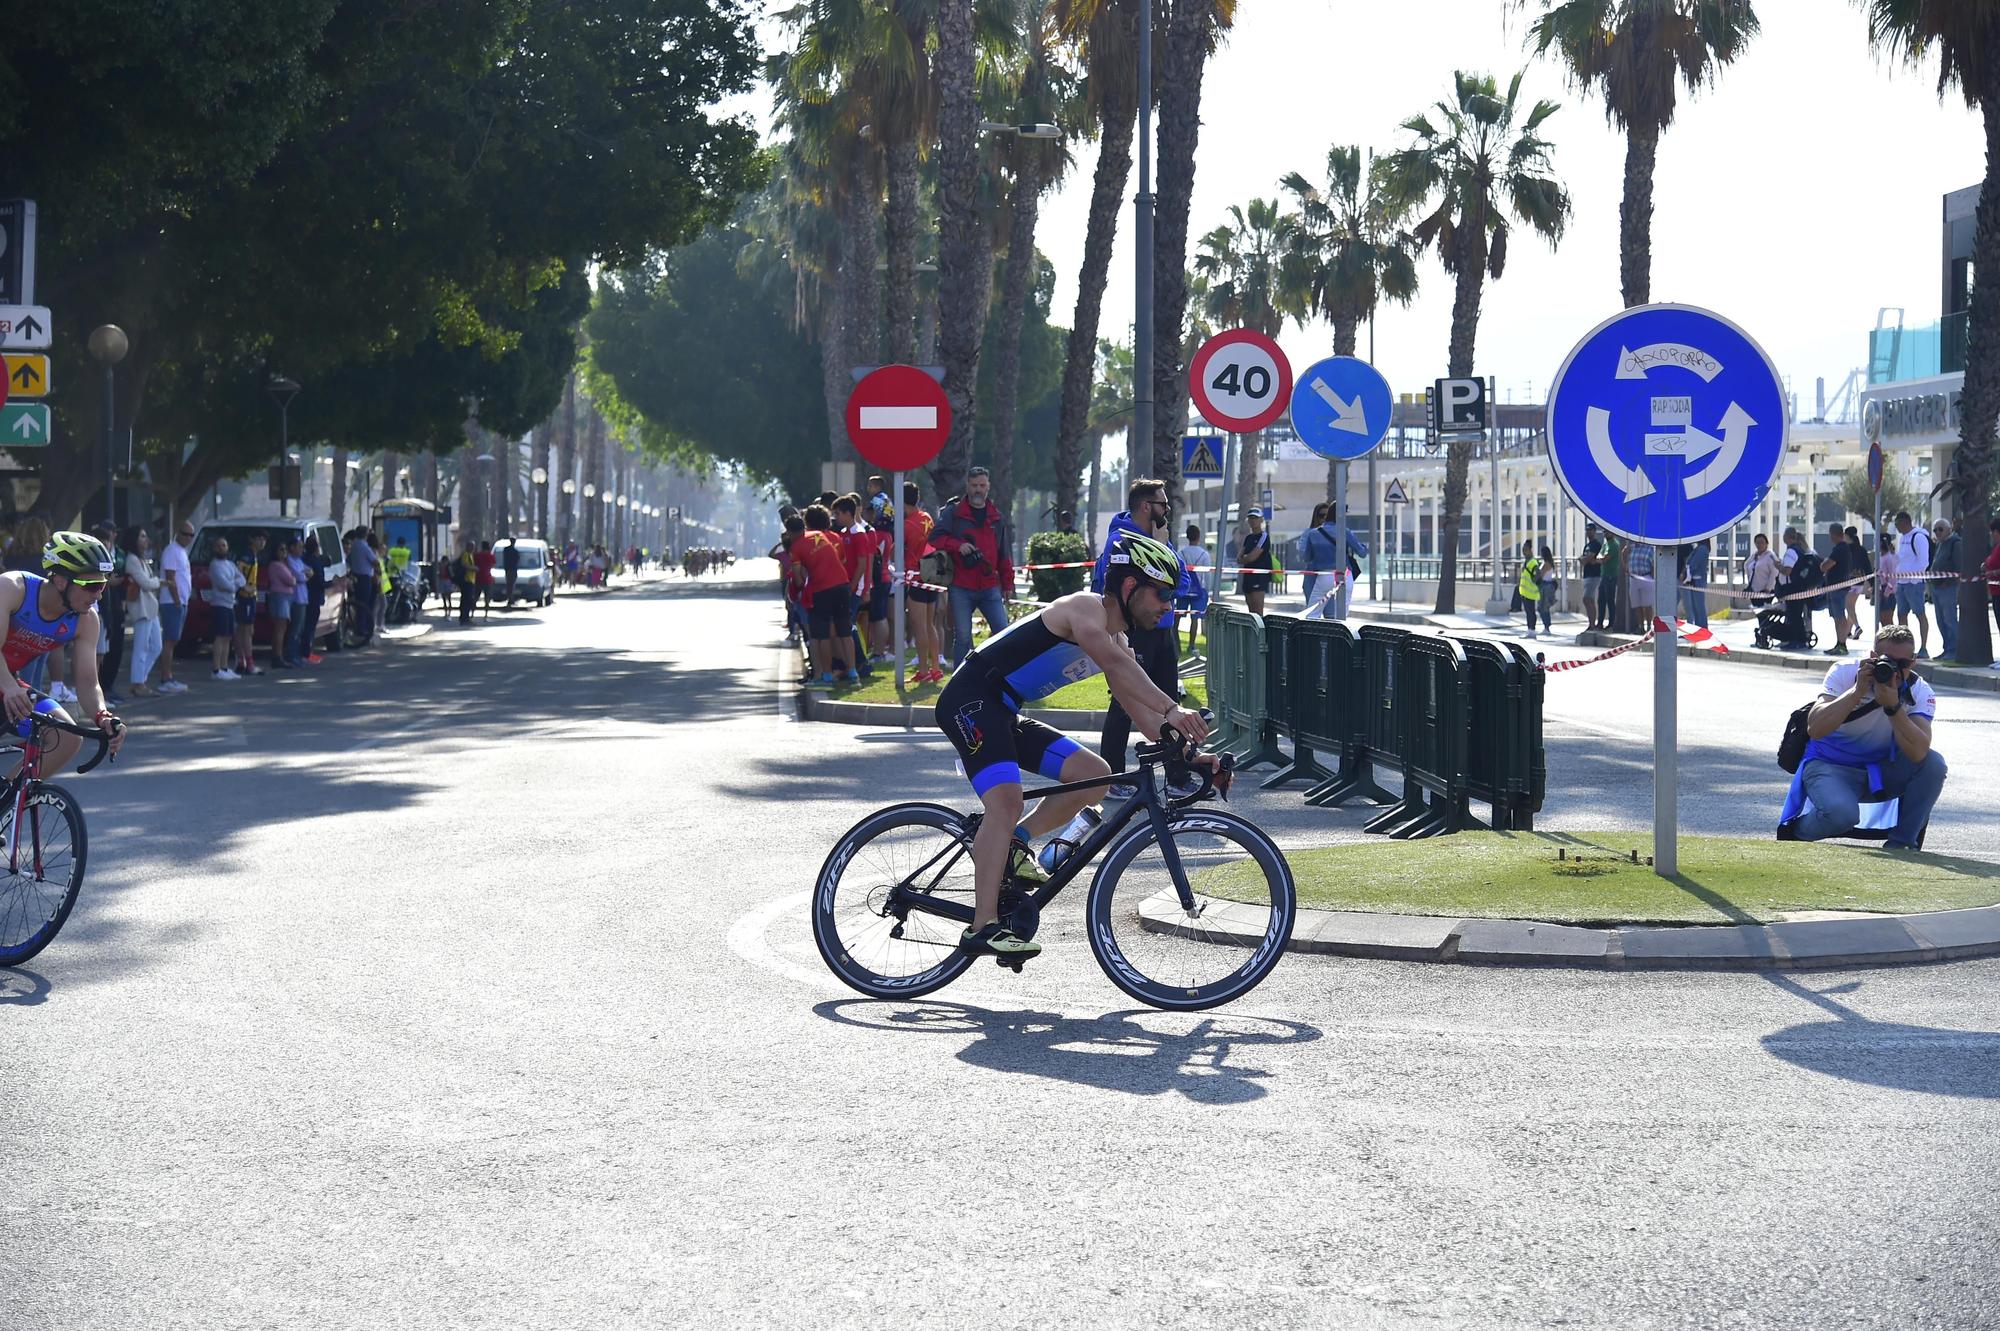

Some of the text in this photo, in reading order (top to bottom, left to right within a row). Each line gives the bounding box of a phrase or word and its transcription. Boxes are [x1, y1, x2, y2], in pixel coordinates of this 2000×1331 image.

[1212, 363, 1271, 400] 40
[1441, 379, 1479, 422] P
[1882, 394, 1947, 435] BURGER
[822, 842, 855, 915] ZIPP
[1099, 923, 1149, 984] ZIPP
[1241, 905, 1282, 977] ZIPP
[871, 964, 944, 987] ZIPP
